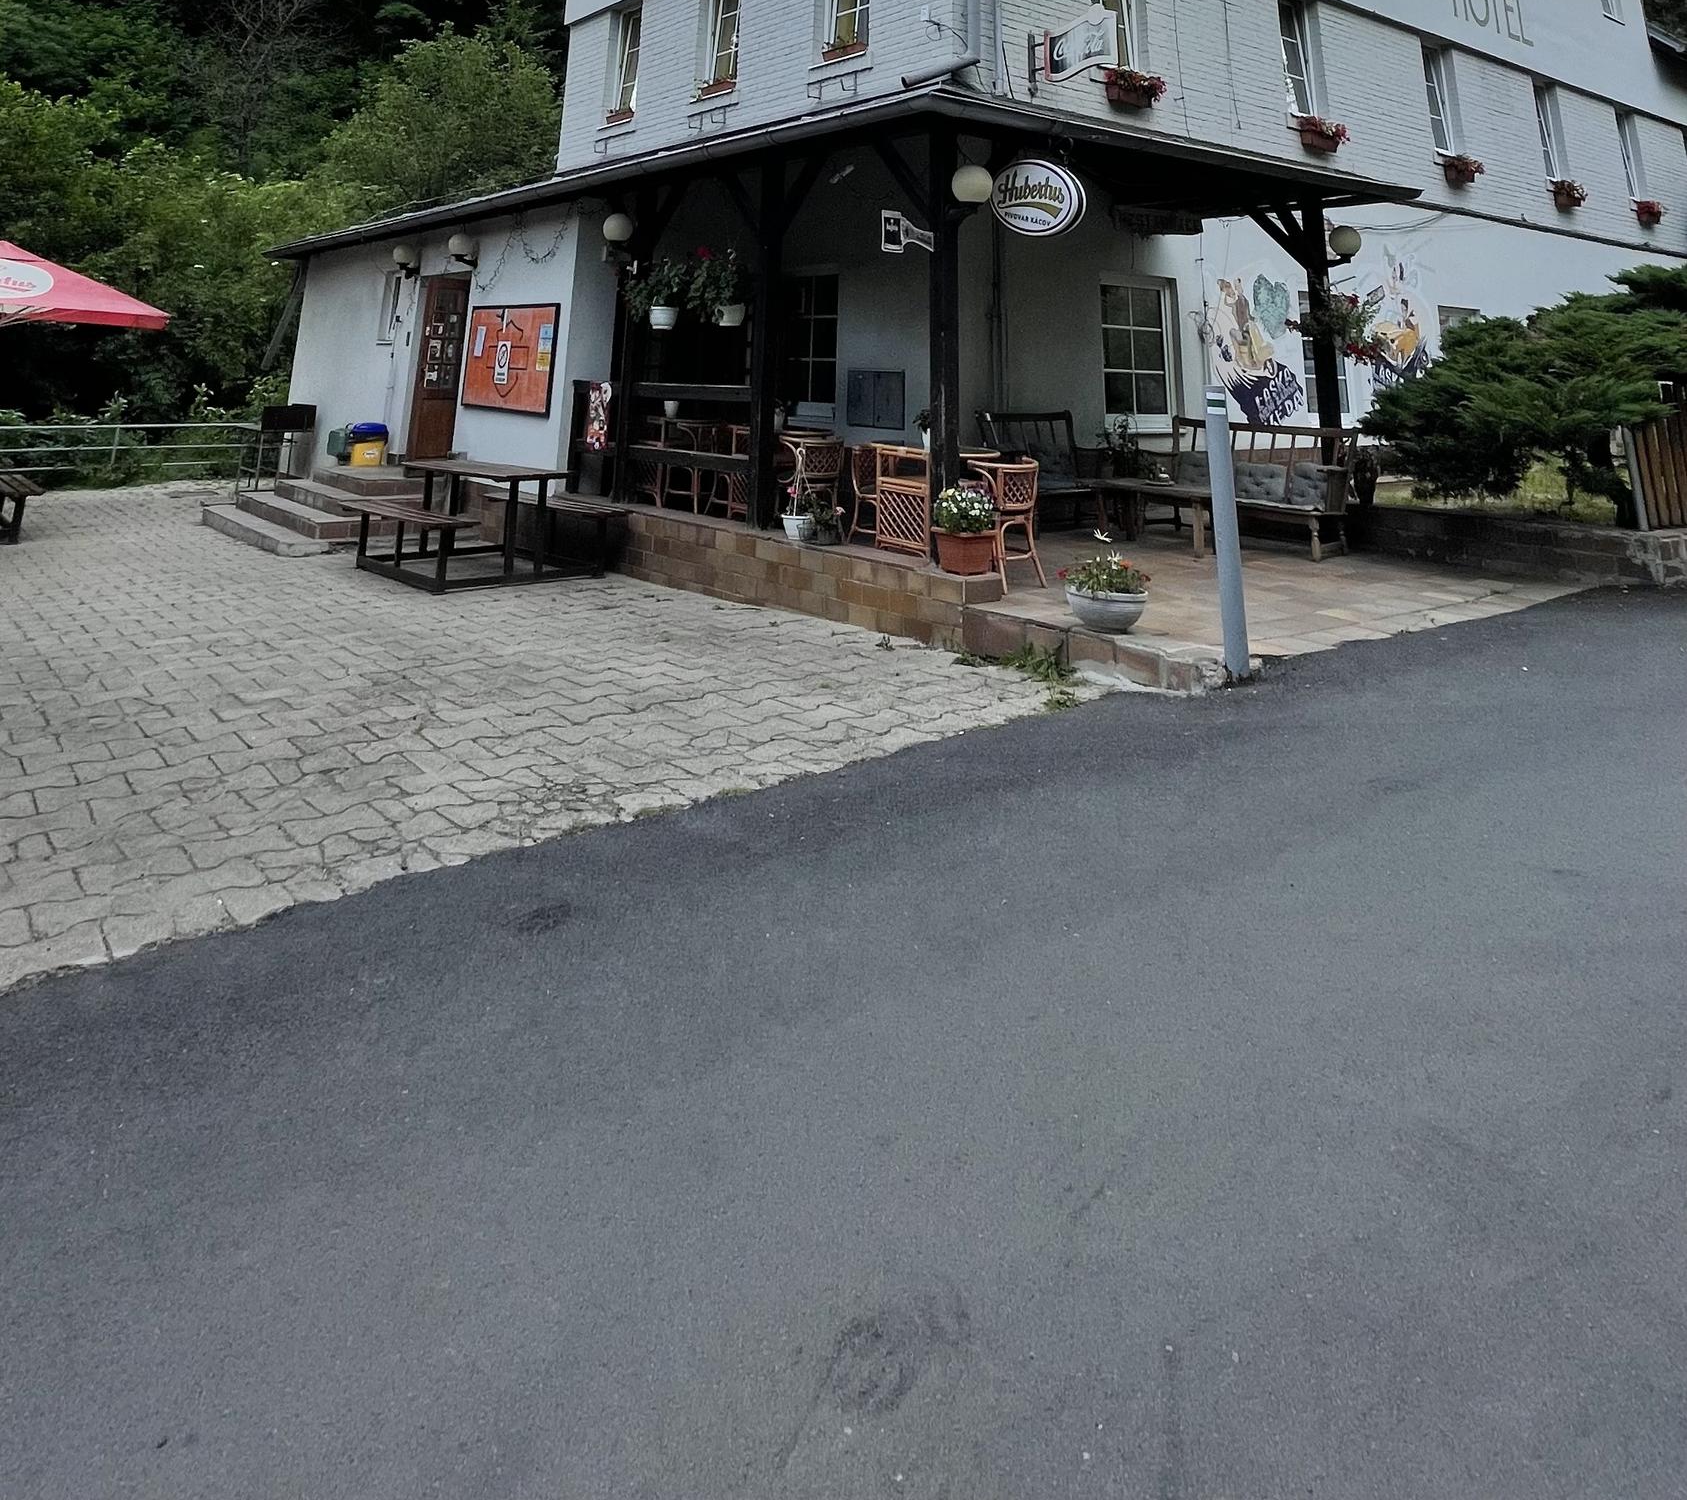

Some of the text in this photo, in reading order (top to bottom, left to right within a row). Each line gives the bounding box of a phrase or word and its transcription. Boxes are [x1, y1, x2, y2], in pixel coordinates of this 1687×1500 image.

[998, 169, 1065, 204] Hubertus
[1004, 211, 1052, 227] PIVOVAR KÁCOV
